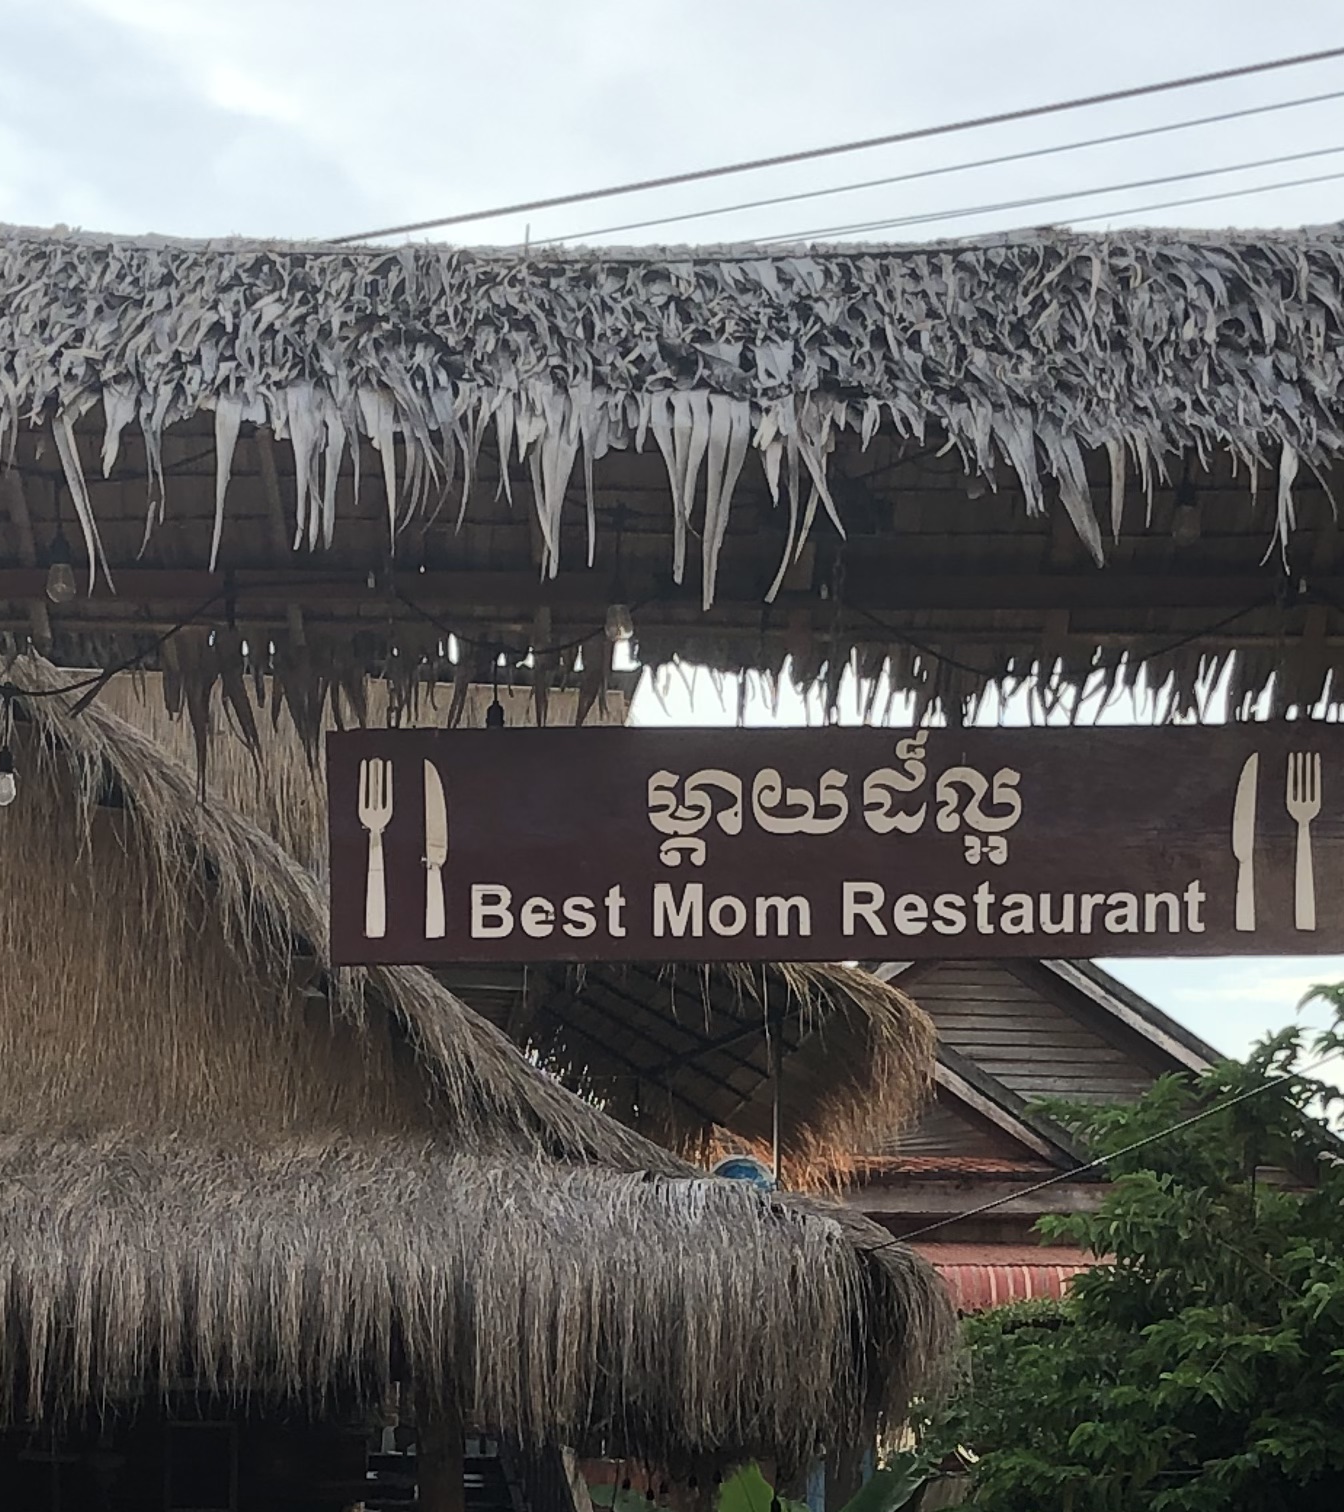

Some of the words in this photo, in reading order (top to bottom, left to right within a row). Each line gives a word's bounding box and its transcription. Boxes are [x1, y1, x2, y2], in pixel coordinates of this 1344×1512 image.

[471, 882, 626, 939] Best
[653, 882, 812, 938] Mom
[842, 878, 1206, 936] Restaurant
